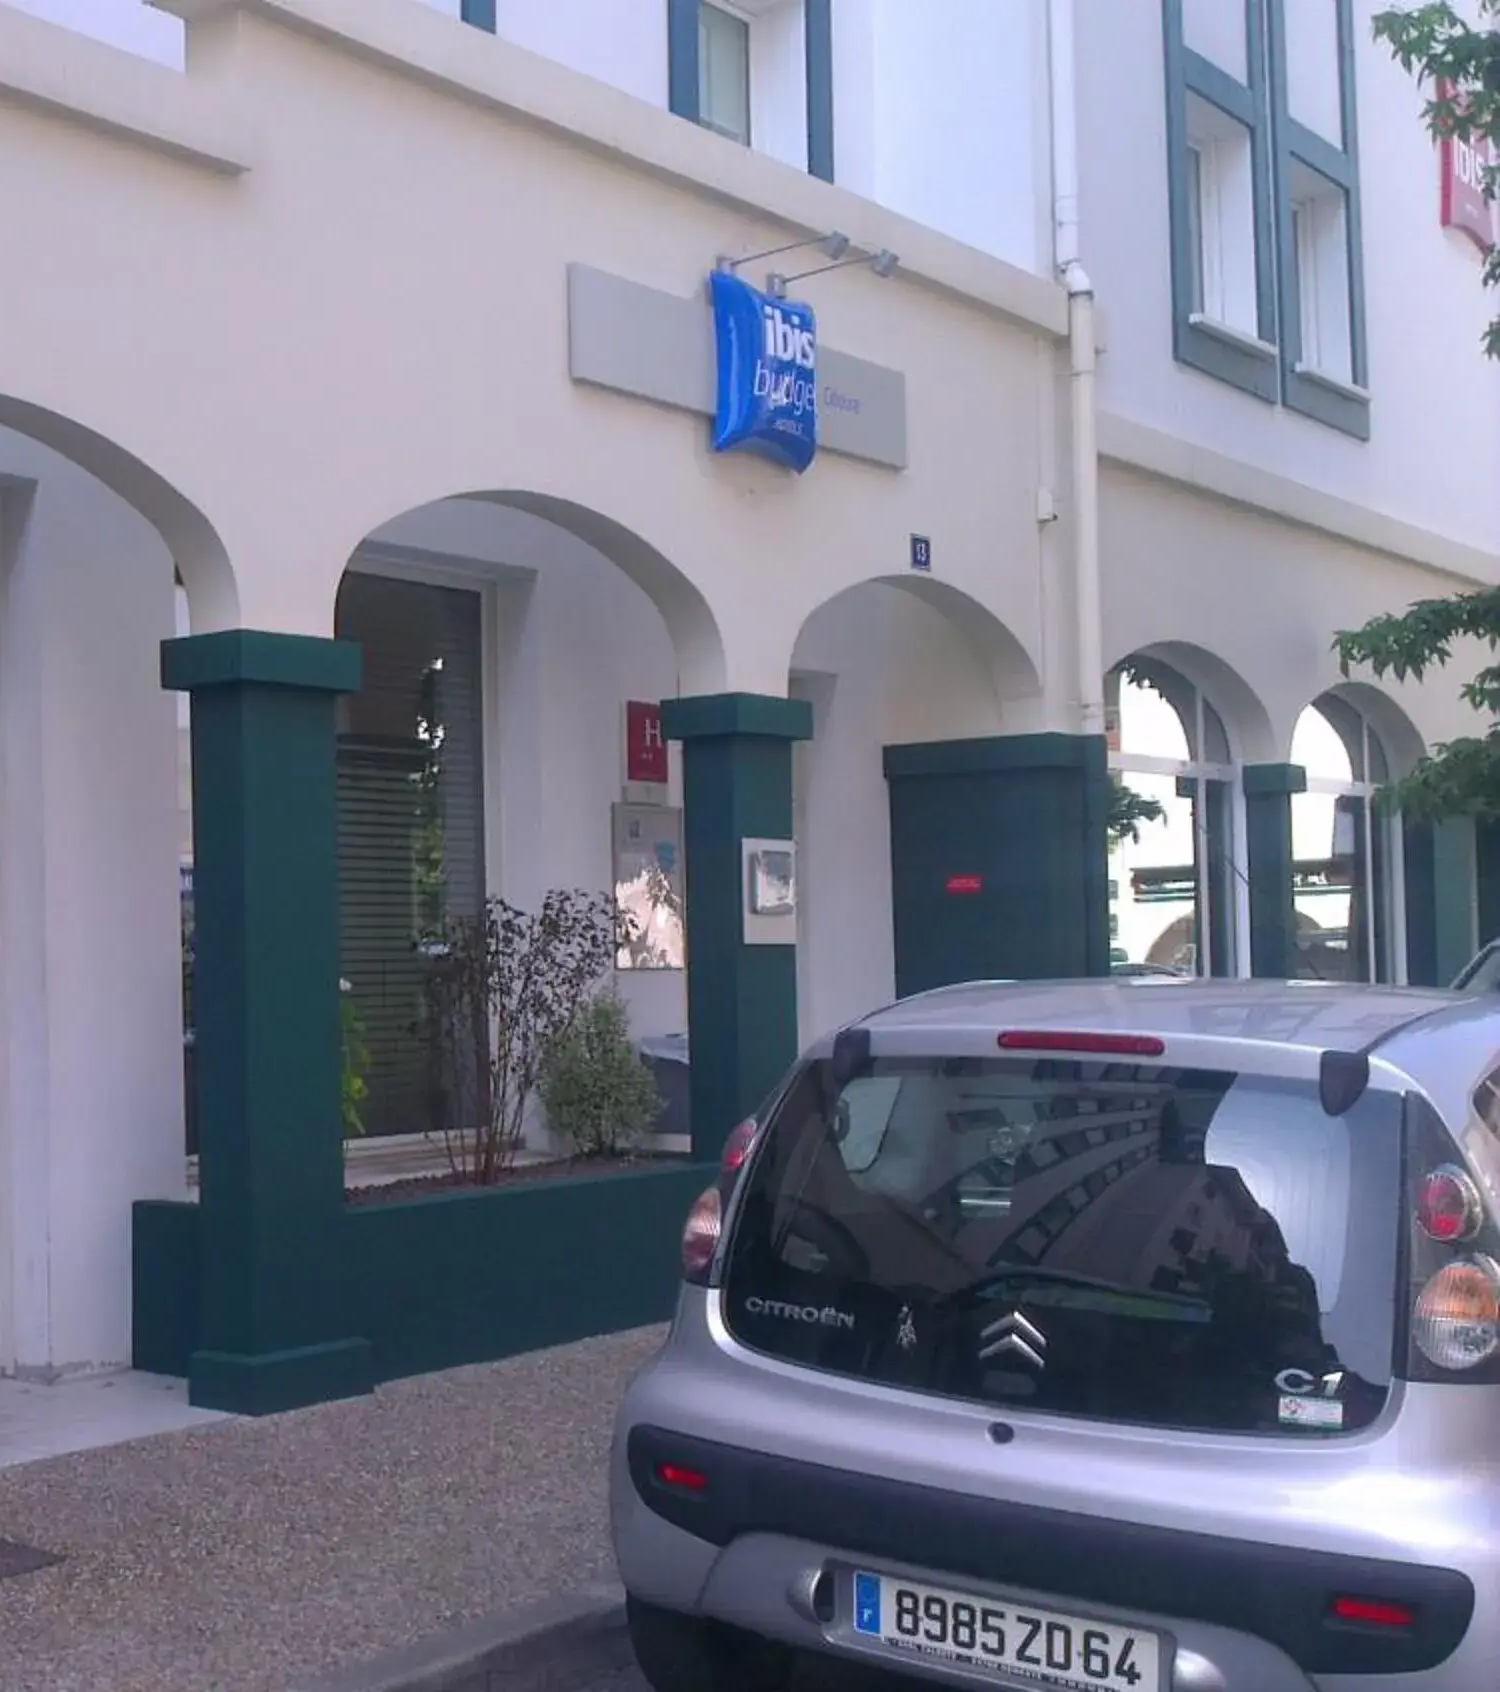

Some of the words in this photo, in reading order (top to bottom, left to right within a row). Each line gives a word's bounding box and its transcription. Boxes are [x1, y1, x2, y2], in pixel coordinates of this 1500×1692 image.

[763, 304, 815, 369] ibis
[753, 359, 816, 416] budge
[915, 543, 927, 561] 13
[644, 718, 663, 748] H
[745, 1296, 856, 1329] CITROËN
[1274, 1368, 1344, 1396] C1
[895, 1588, 1006, 1657] 8985
[1016, 1615, 1072, 1672] ZD
[1082, 1629, 1142, 1686] 64
